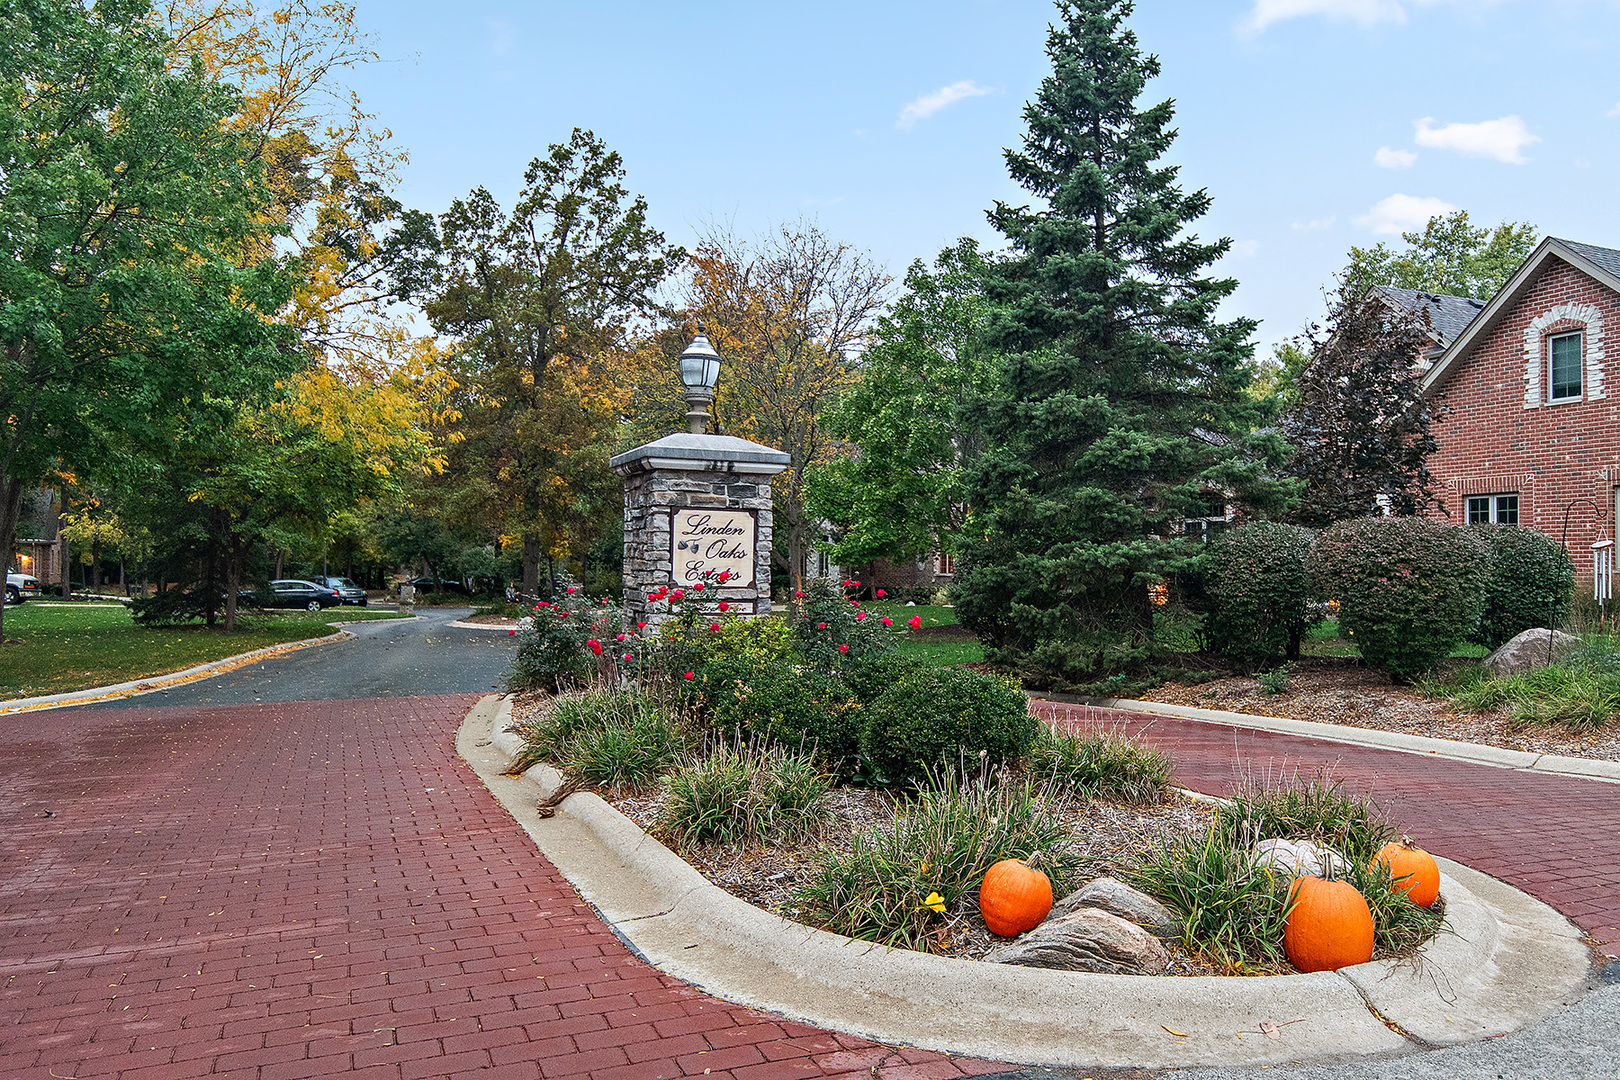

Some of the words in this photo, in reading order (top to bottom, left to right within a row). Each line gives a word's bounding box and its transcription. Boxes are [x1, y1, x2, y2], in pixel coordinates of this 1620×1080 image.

[682, 514, 745, 535] Linden
[705, 538, 747, 559] Oaks
[685, 560, 741, 581] Estaes
